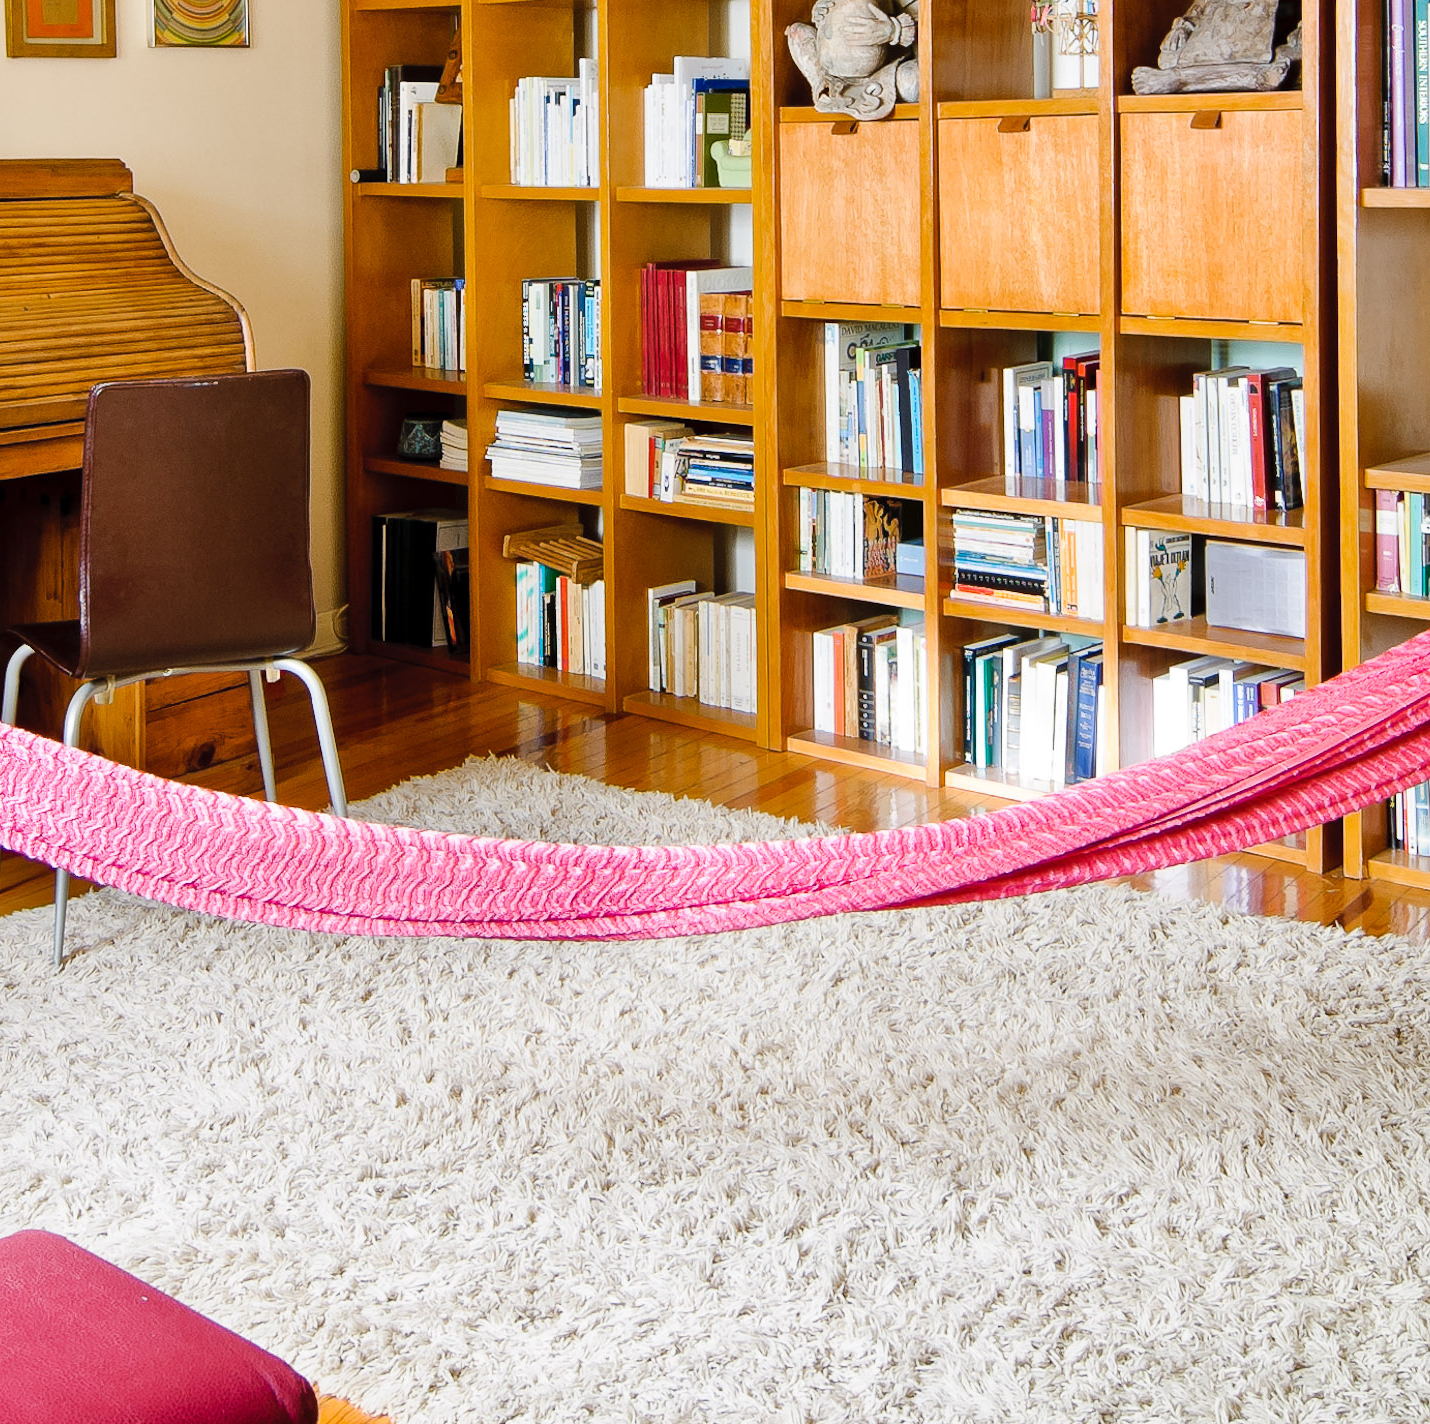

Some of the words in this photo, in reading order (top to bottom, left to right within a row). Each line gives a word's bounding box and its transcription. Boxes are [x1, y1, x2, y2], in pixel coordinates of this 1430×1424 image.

[1417, 19, 1429, 72] SOUTHERN
[1417, 74, 1429, 125] INTERIORS
[841, 325, 863, 336] DAVID
